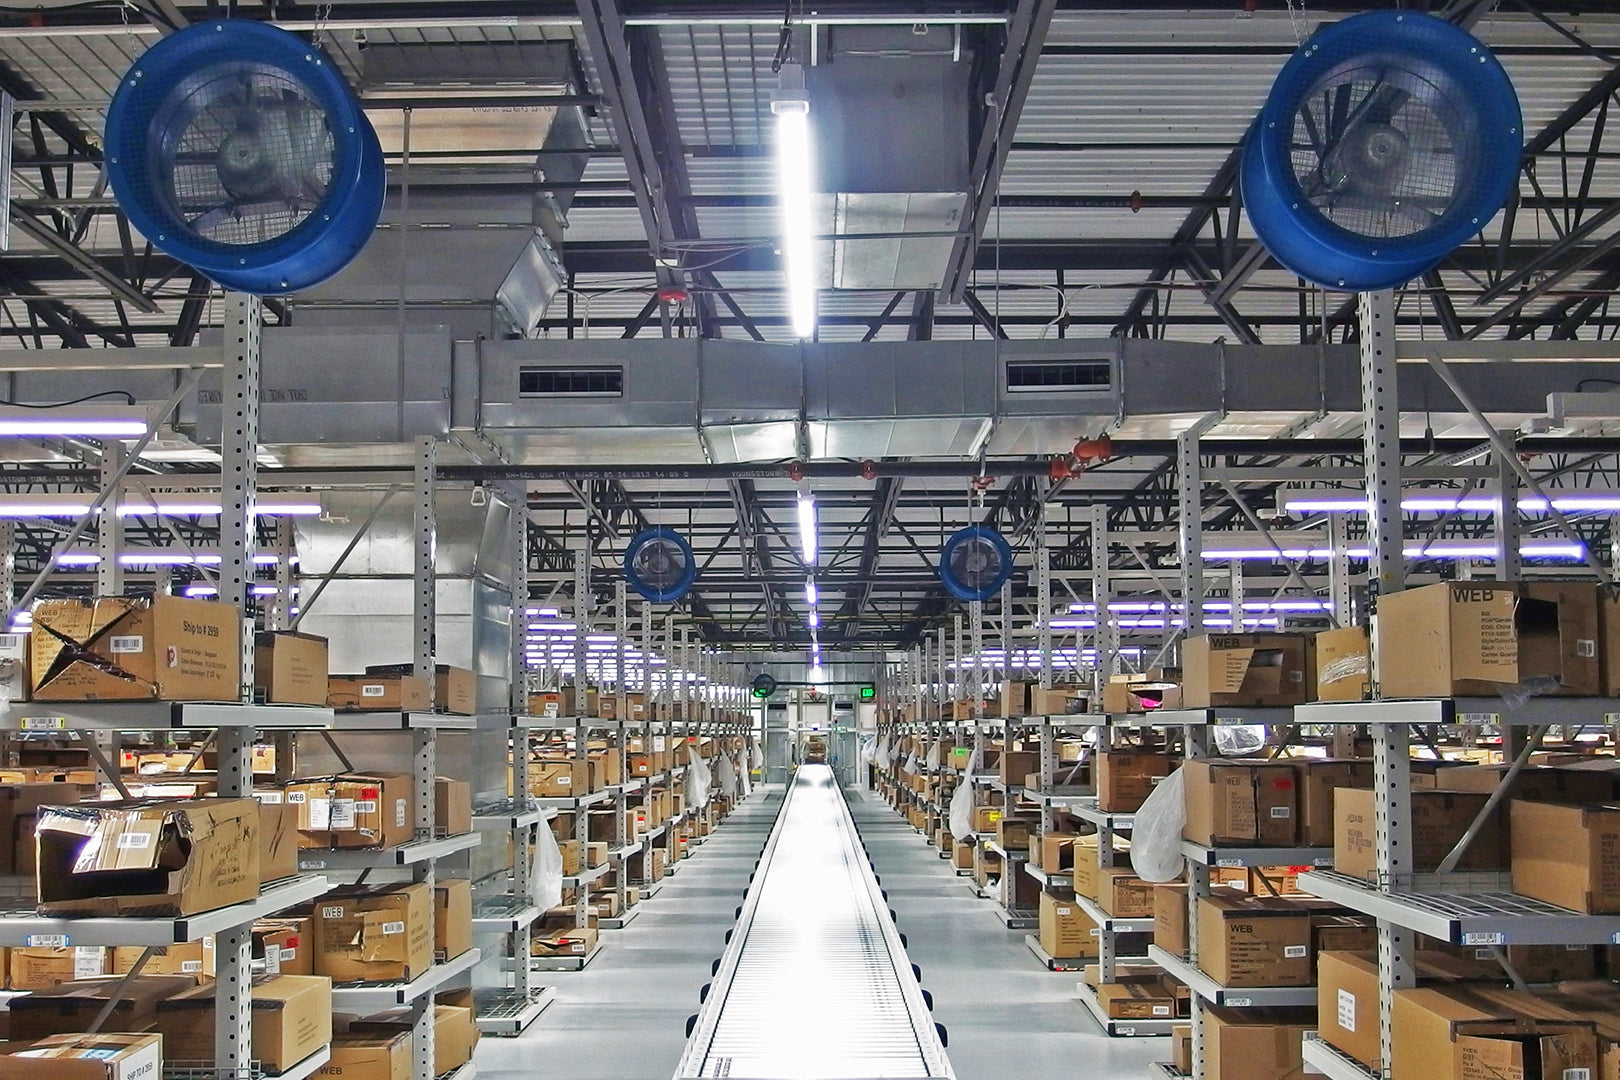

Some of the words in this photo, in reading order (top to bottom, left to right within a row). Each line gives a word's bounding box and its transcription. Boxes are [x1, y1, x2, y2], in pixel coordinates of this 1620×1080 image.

[1453, 588, 1494, 603] WEB
[183, 620, 196, 636] Ship
[1212, 638, 1240, 648] WEB
[290, 793, 304, 802] WEB
[324, 907, 342, 917] WEB
[1230, 924, 1253, 934] WEB
[320, 1066, 343, 1075] WEB
